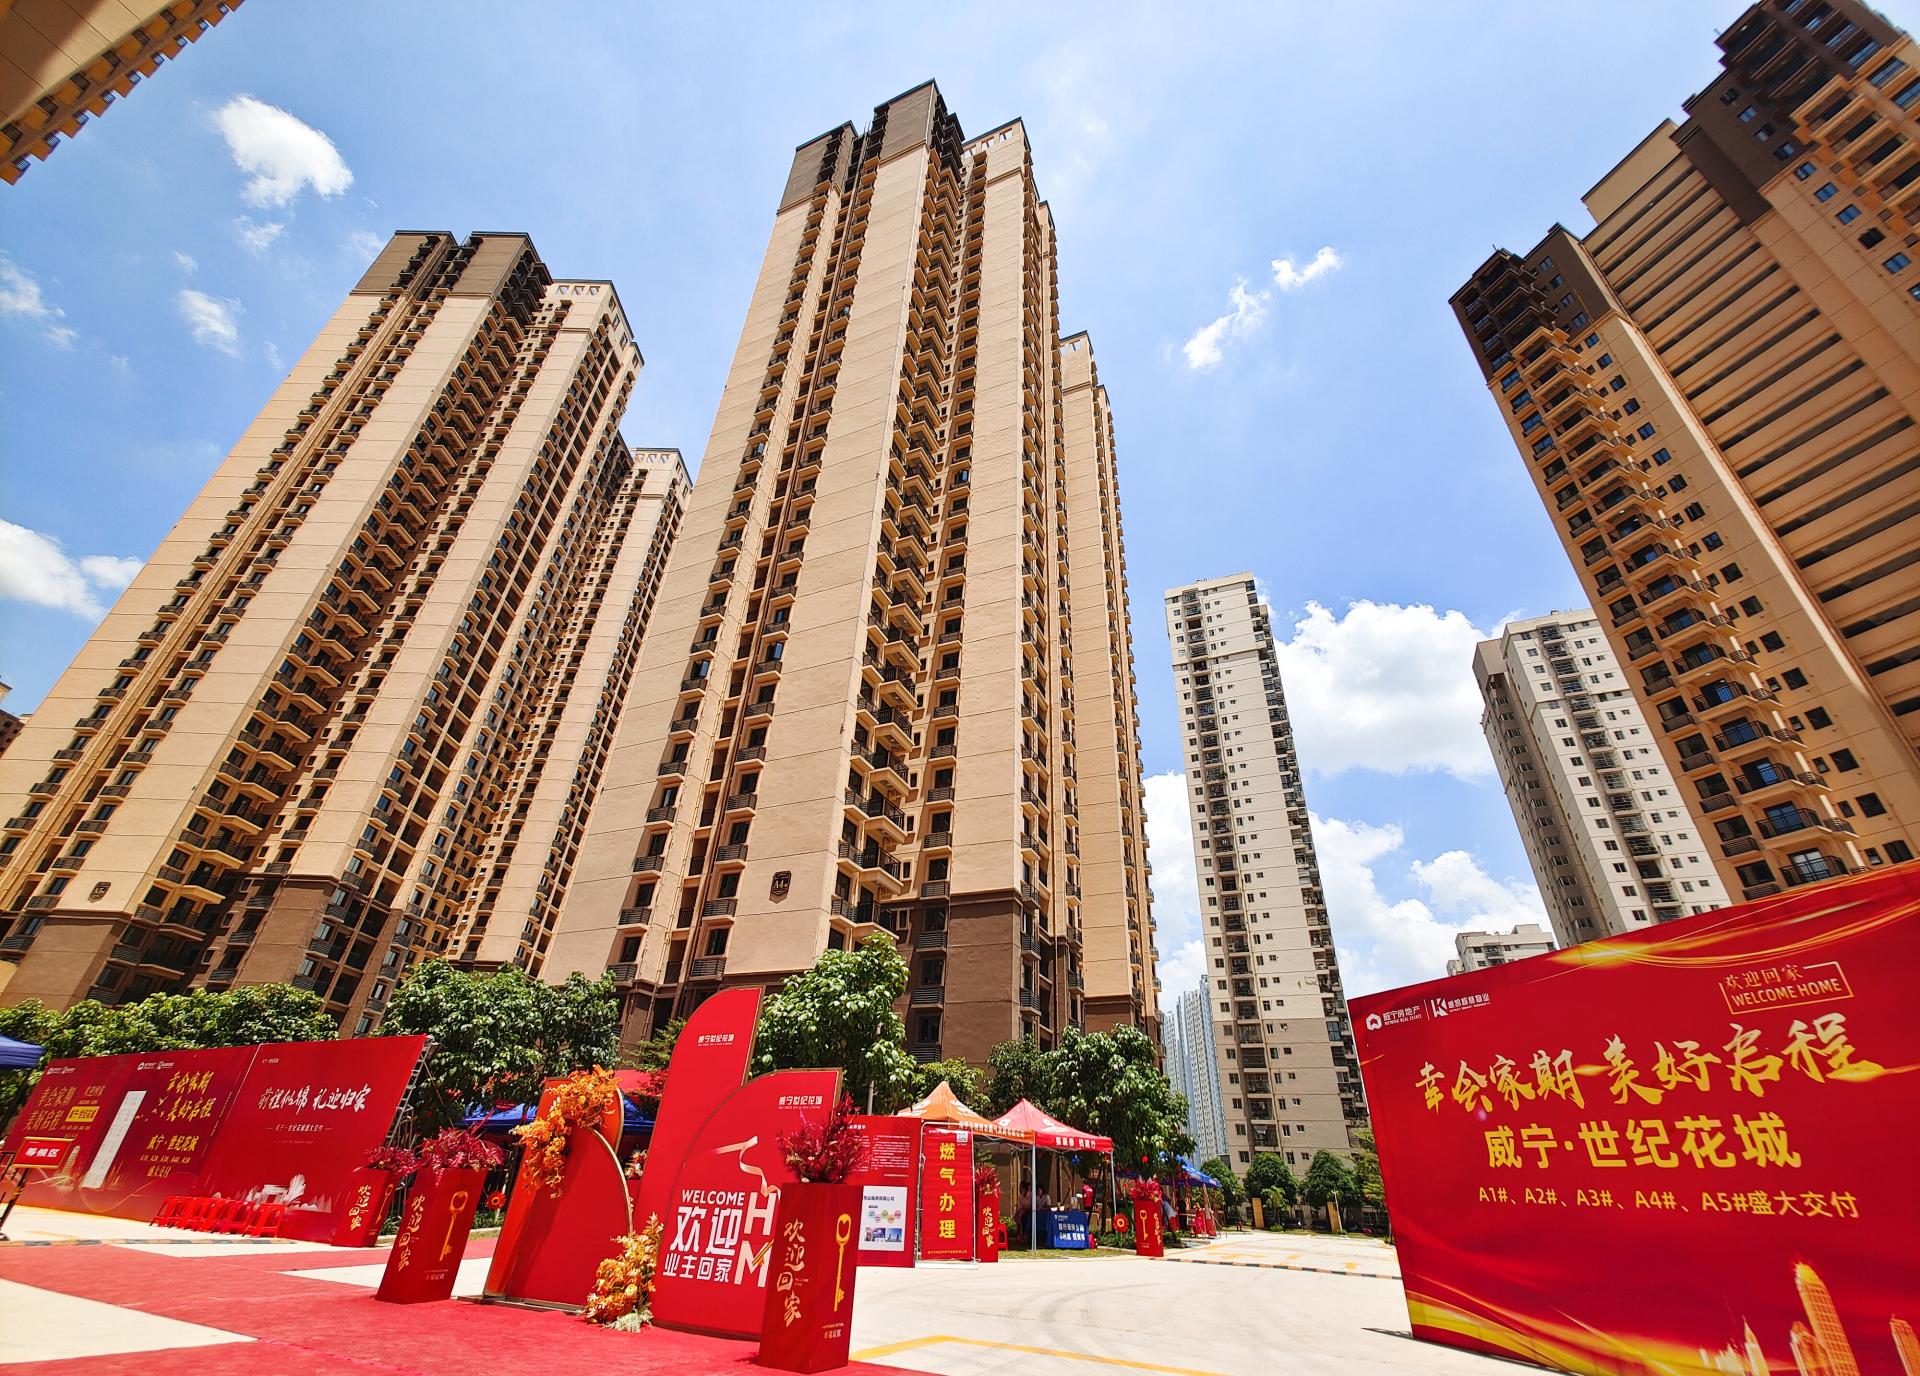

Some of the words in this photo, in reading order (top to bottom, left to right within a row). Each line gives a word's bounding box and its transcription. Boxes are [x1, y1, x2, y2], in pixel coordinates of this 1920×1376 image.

[1725, 964, 1803, 990] 欢迎回家
[1731, 985, 1797, 1007] WELCOME
[1797, 978, 1842, 997] HOME
[1383, 1005, 1420, 1021] 威宁房地产
[1415, 1048, 1585, 1114] 幸会家期
[1602, 1013, 1884, 1105] 美好启程
[258, 1084, 310, 1115] 前程似锦
[312, 1083, 371, 1112] 礼迎归家
[25, 1147, 60, 1157] 等候区
[1484, 1112, 1802, 1169] 威宁·世纪花城
[348, 1184, 371, 1231] 欢迎回家
[681, 1189, 745, 1206] WELCOME
[939, 1143, 955, 1238] 燃气办理
[398, 1194, 425, 1272] 欢迎回家
[670, 1206, 743, 1257] 欢迎
[982, 1206, 994, 1248] 欢迎回家
[663, 1253, 733, 1283] 业主回家
[776, 1218, 805, 1327] 欢迎回家
